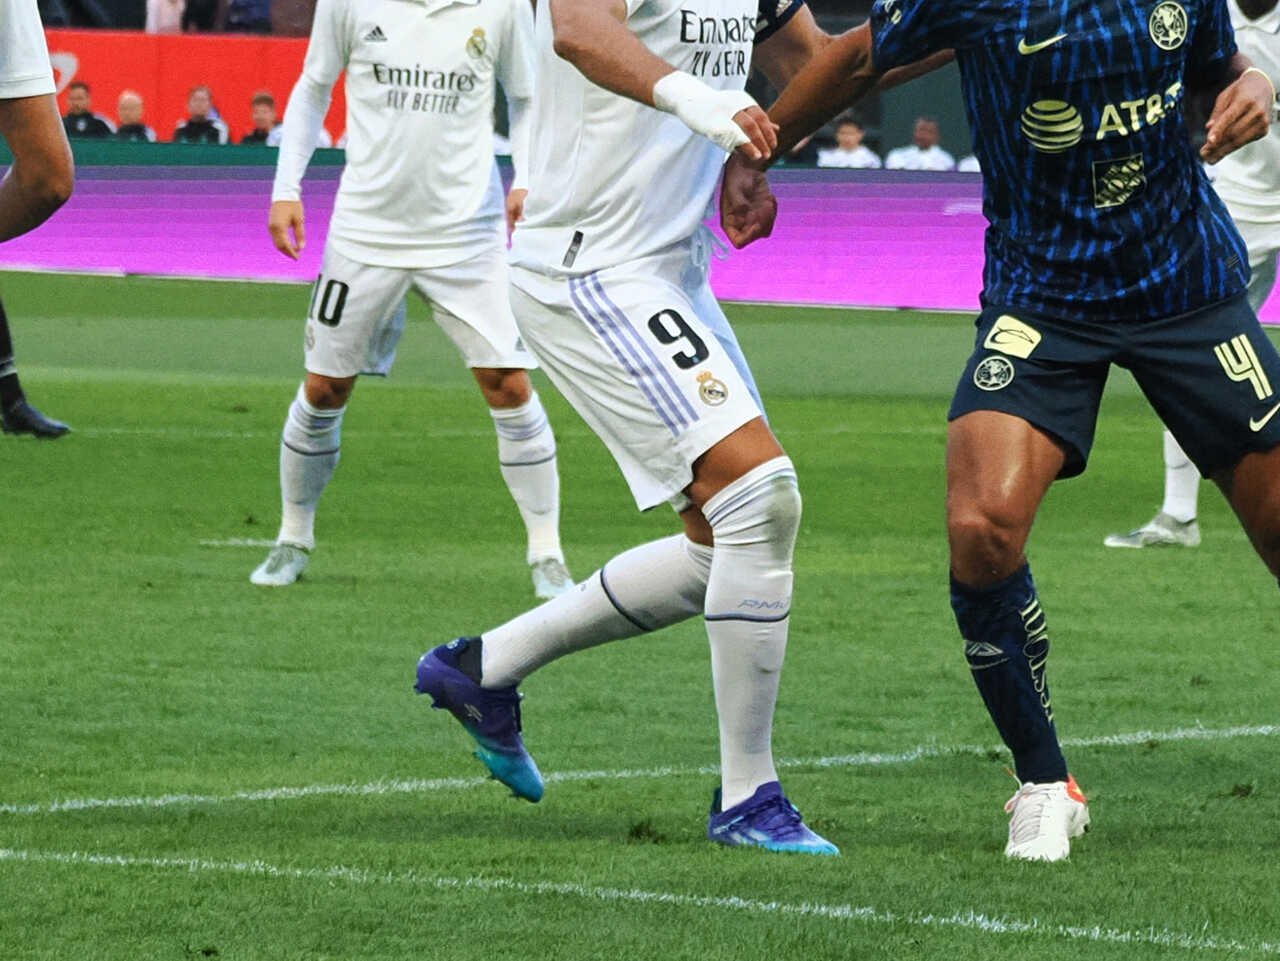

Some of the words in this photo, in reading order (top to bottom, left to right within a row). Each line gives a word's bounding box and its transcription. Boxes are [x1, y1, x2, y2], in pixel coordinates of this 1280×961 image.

[372, 63, 476, 92] Emirates
[387, 89, 409, 111] FLY
[411, 92, 460, 115] BETTER
[647, 308, 710, 371] 9
[1213, 333, 1274, 401] 4
